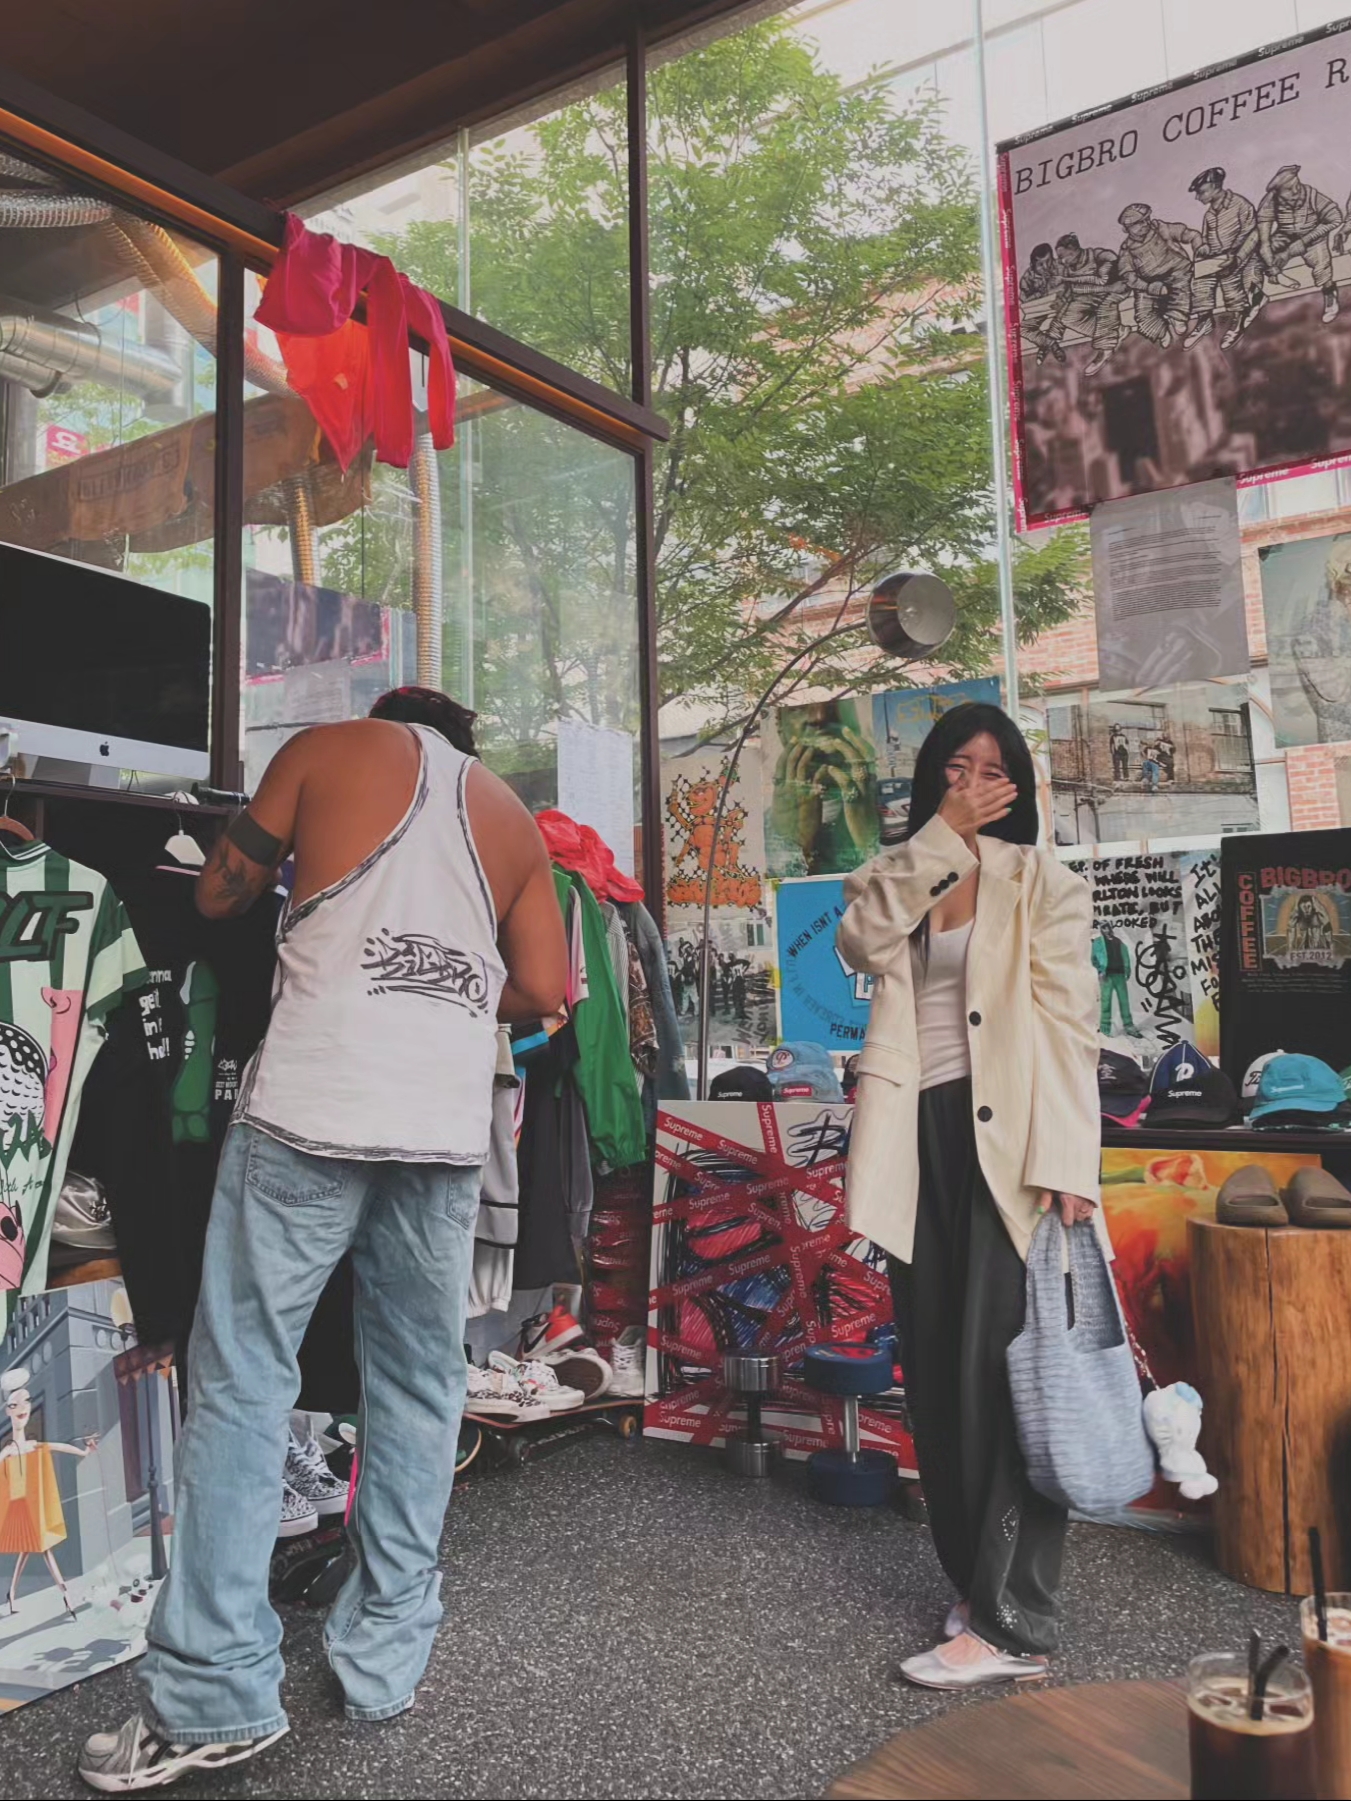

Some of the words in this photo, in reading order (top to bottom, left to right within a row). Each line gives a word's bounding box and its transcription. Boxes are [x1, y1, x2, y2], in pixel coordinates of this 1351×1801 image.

[1258, 36, 1304, 57] Supreme
[1193, 59, 1238, 80] Supreme
[1131, 81, 1174, 104] Supreme
[1071, 104, 1113, 124] Supreme
[1013, 130, 1138, 195] BIGBRO
[1162, 72, 1300, 142] COFFEE
[1014, 125, 1054, 145] Supreme
[1240, 468, 1290, 485] Supreme
[1093, 858, 1111, 871] OF
[1115, 856, 1164, 870] FRESH
[1094, 870, 1141, 886] WHERE
[1145, 870, 1180, 884] WILL
[1261, 866, 1351, 891] BIGBRO
[1141, 885, 1183, 899] LOOKS
[1148, 900, 1184, 915] BUT
[1238, 874, 1258, 969] COFFEE
[787, 928, 813, 958] WHEN
[810, 911, 833, 935] ISNT
[717, 1090, 743, 1100] Supreme
[782, 1086, 810, 1094] Supreme
[1167, 1089, 1203, 1099] Supreme
[664, 1116, 704, 1142] Supreme
[761, 1104, 778, 1154] Supreme
[717, 1139, 758, 1165] Supreme
[745, 1177, 790, 1196] Supreme
[688, 1192, 731, 1211] Supreme
[727, 1253, 771, 1276] Supreme
[789, 1245, 808, 1299] Supreme
[671, 1274, 714, 1297] Supreme
[830, 1312, 877, 1338] Supreme
[660, 1334, 703, 1360] Supreme
[658, 1410, 702, 1428] Supreme
